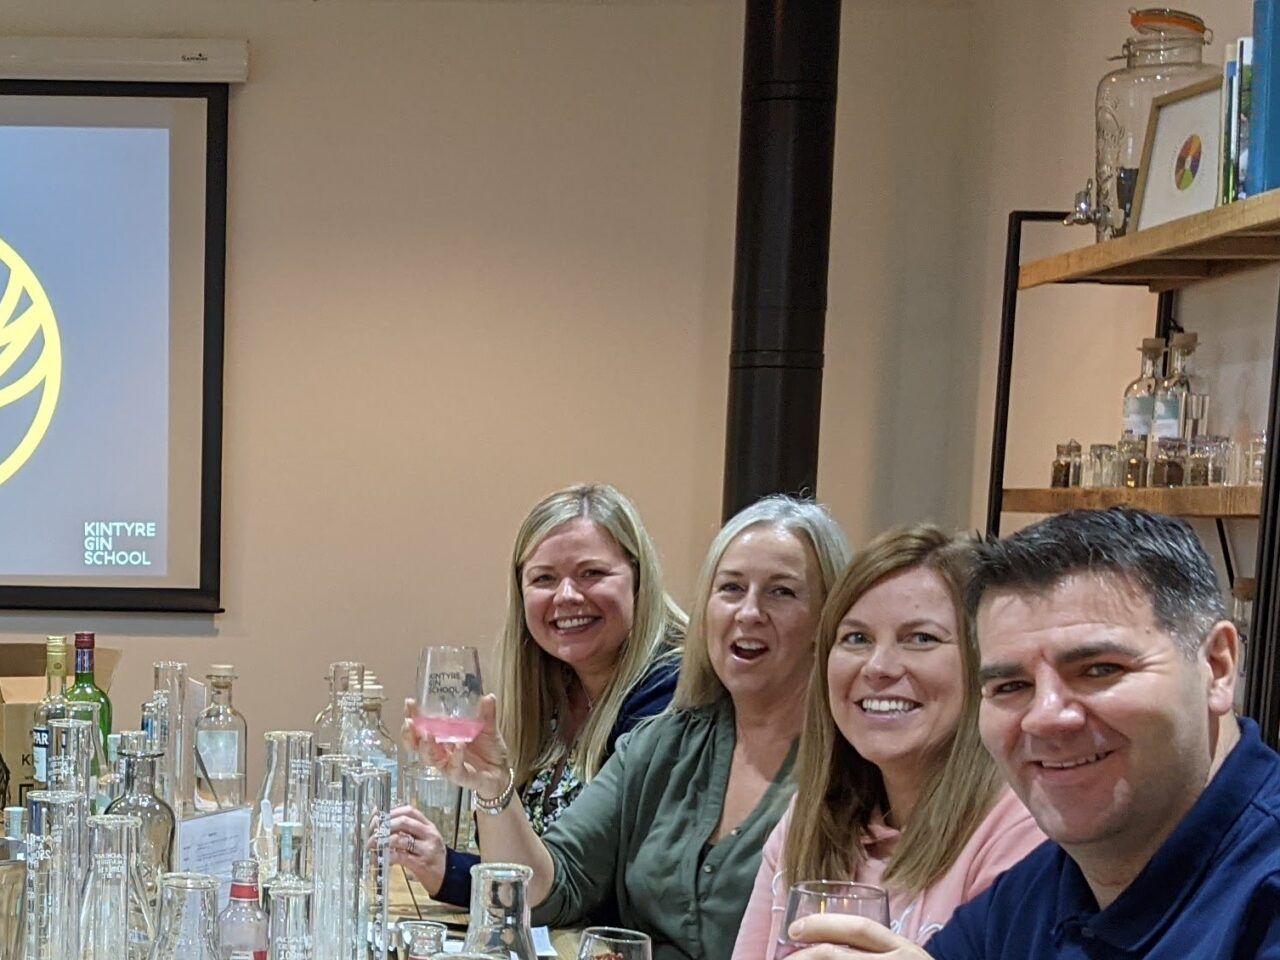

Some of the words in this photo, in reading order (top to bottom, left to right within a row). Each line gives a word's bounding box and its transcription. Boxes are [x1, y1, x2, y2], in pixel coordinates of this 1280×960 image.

[84, 521, 156, 537] KINTYRE
[84, 536, 112, 551] GIN
[84, 550, 152, 566] SCHOOL
